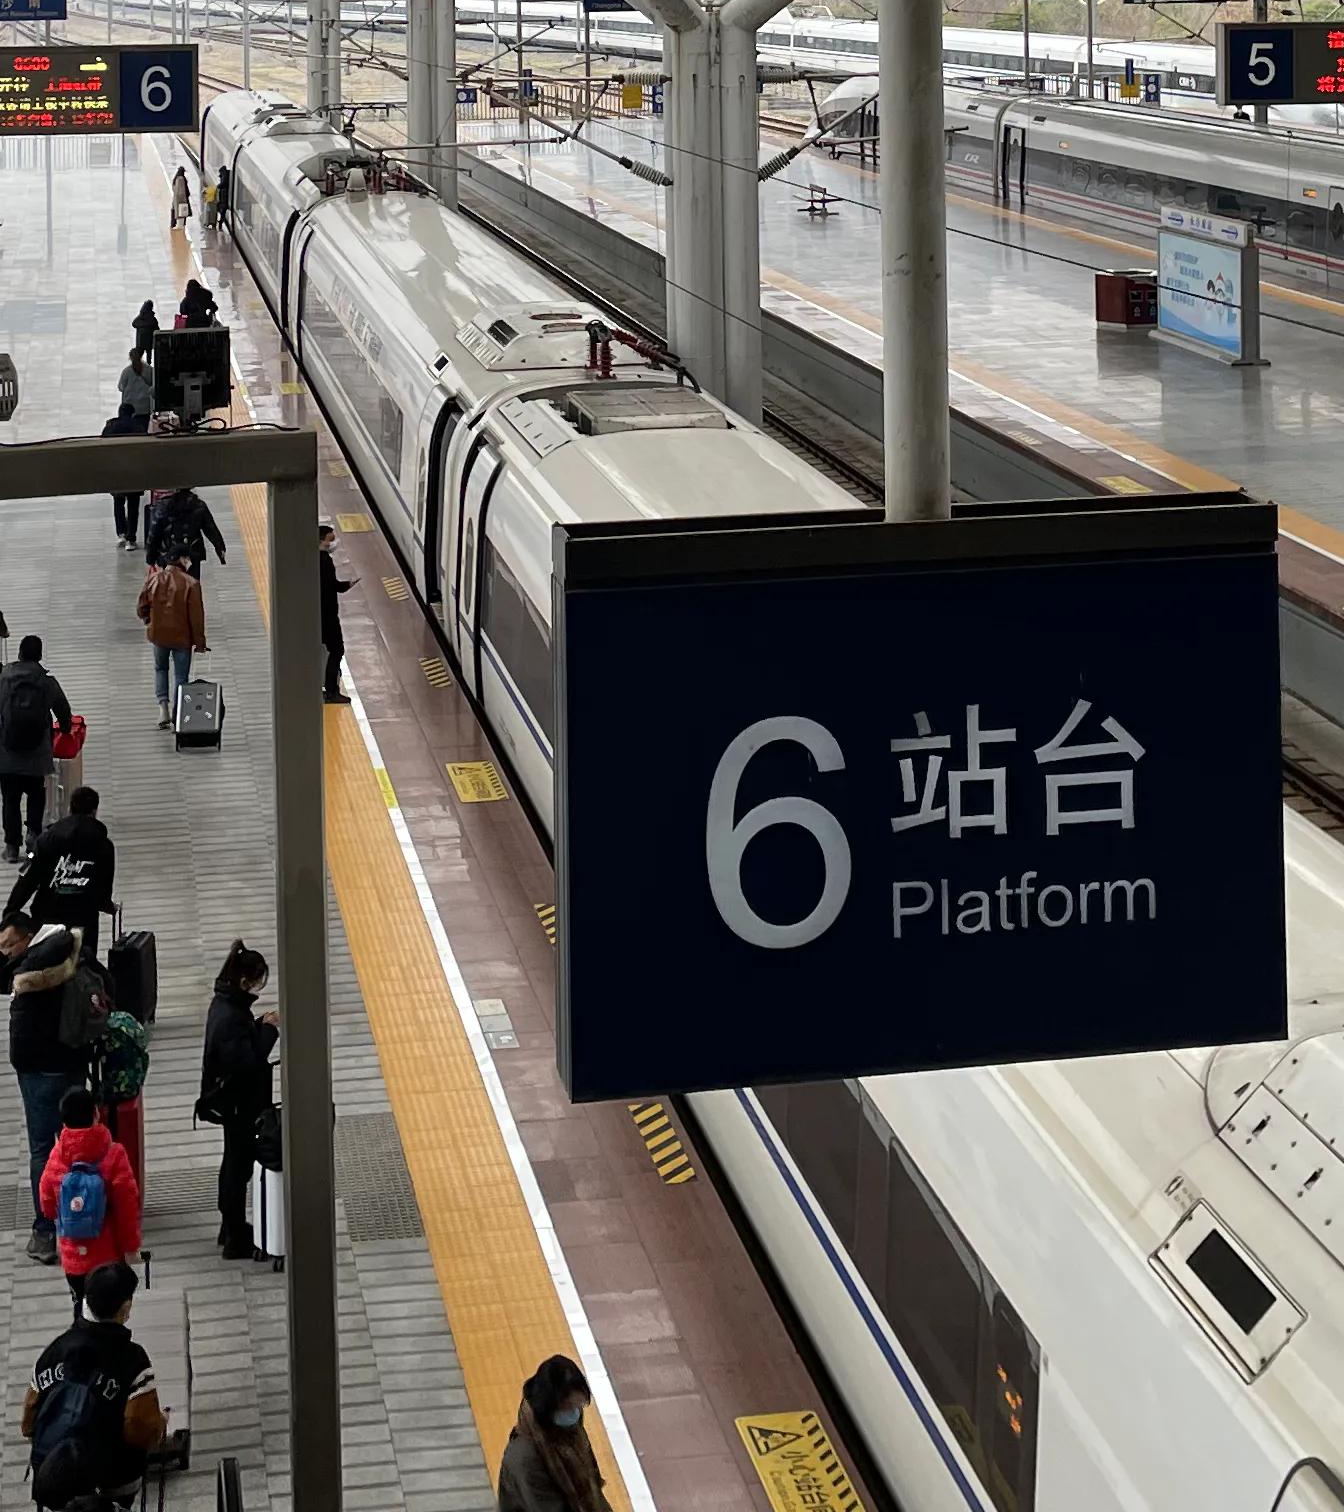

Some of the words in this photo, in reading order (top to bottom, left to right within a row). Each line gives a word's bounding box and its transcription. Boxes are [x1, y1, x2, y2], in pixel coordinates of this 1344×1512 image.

[140, 65, 172, 112] 6
[1248, 42, 1276, 86] 5
[890, 699, 1146, 839] 站台
[706, 715, 853, 950] 6
[892, 871, 1157, 939] Platform
